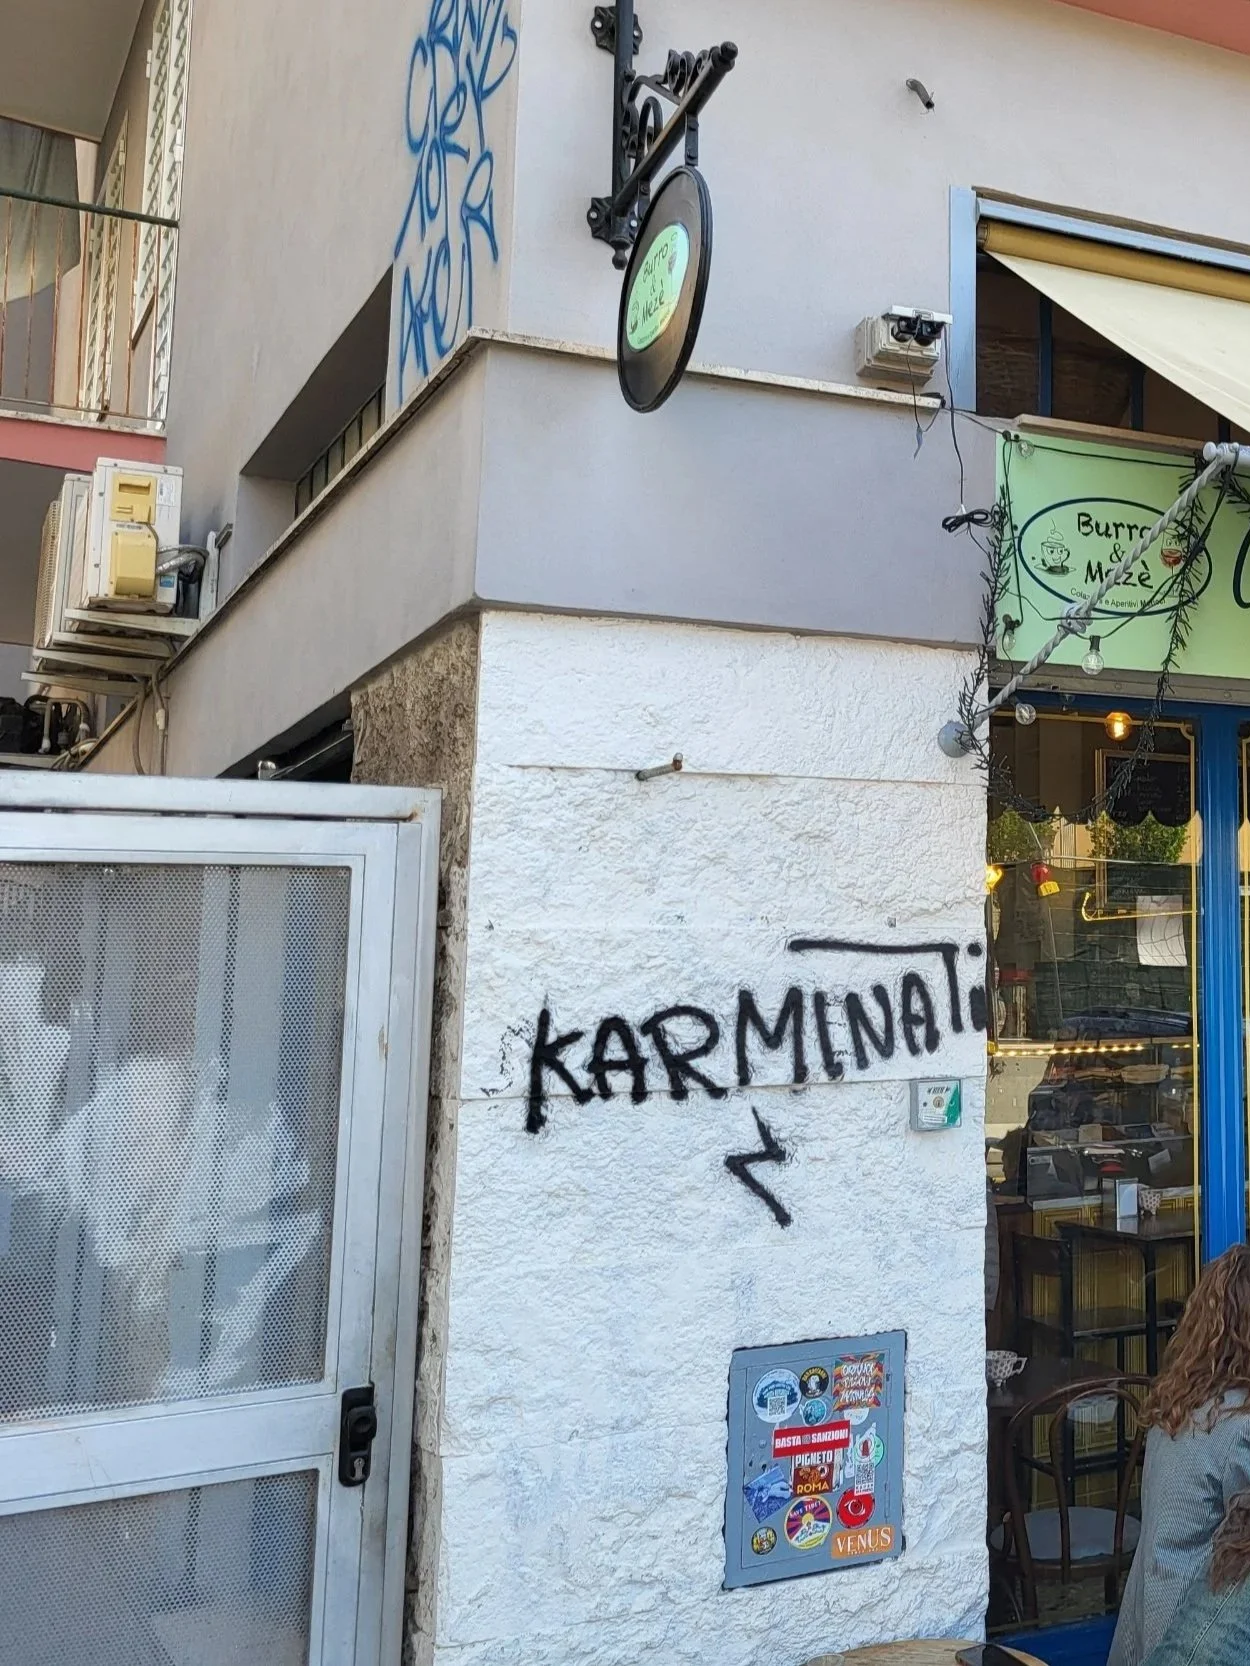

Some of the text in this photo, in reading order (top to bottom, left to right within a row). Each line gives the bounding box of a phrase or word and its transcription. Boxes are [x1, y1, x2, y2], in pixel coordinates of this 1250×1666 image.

[642, 244, 668, 283] Burro
[1109, 542, 1126, 564] &
[775, 1435, 801, 1448] BASTA
[811, 1429, 848, 1443] SANZIONI
[796, 1450, 832, 1466] PIGNETO
[797, 1481, 829, 1494] ROMA
[837, 1527, 891, 1553] VENUS
